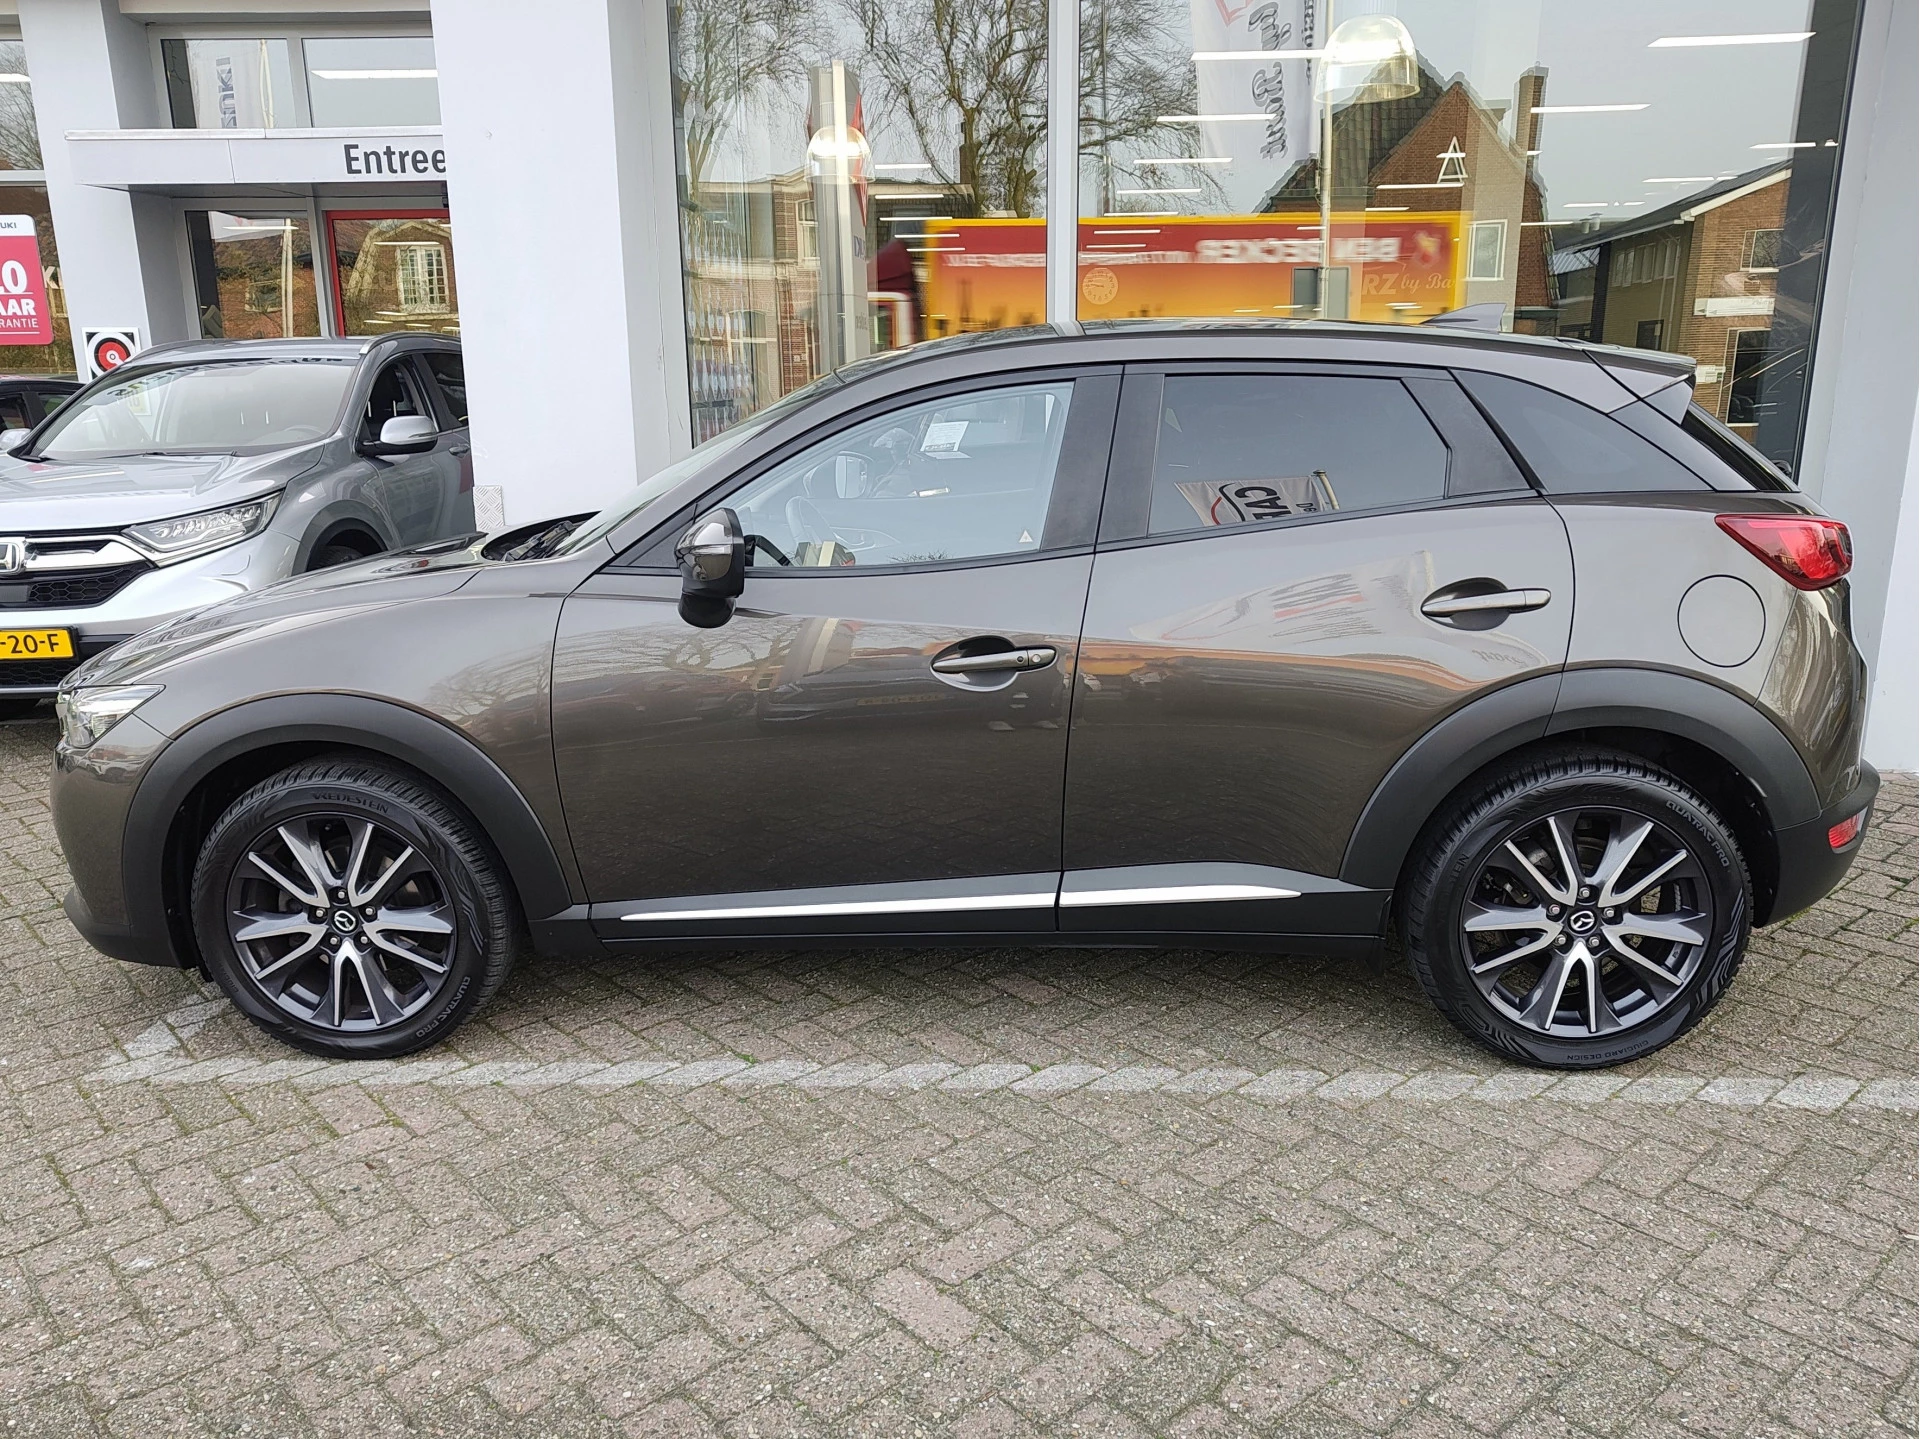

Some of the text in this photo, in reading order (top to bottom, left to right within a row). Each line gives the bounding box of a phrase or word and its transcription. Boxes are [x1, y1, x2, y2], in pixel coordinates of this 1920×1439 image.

[344, 144, 446, 174] Entree
[0, 260, 28, 294] 0
[1361, 273, 1400, 295] RZ
[1665, 800, 1730, 867] QUATRAC PRO
[415, 976, 471, 1038] QUATRAC PRO
